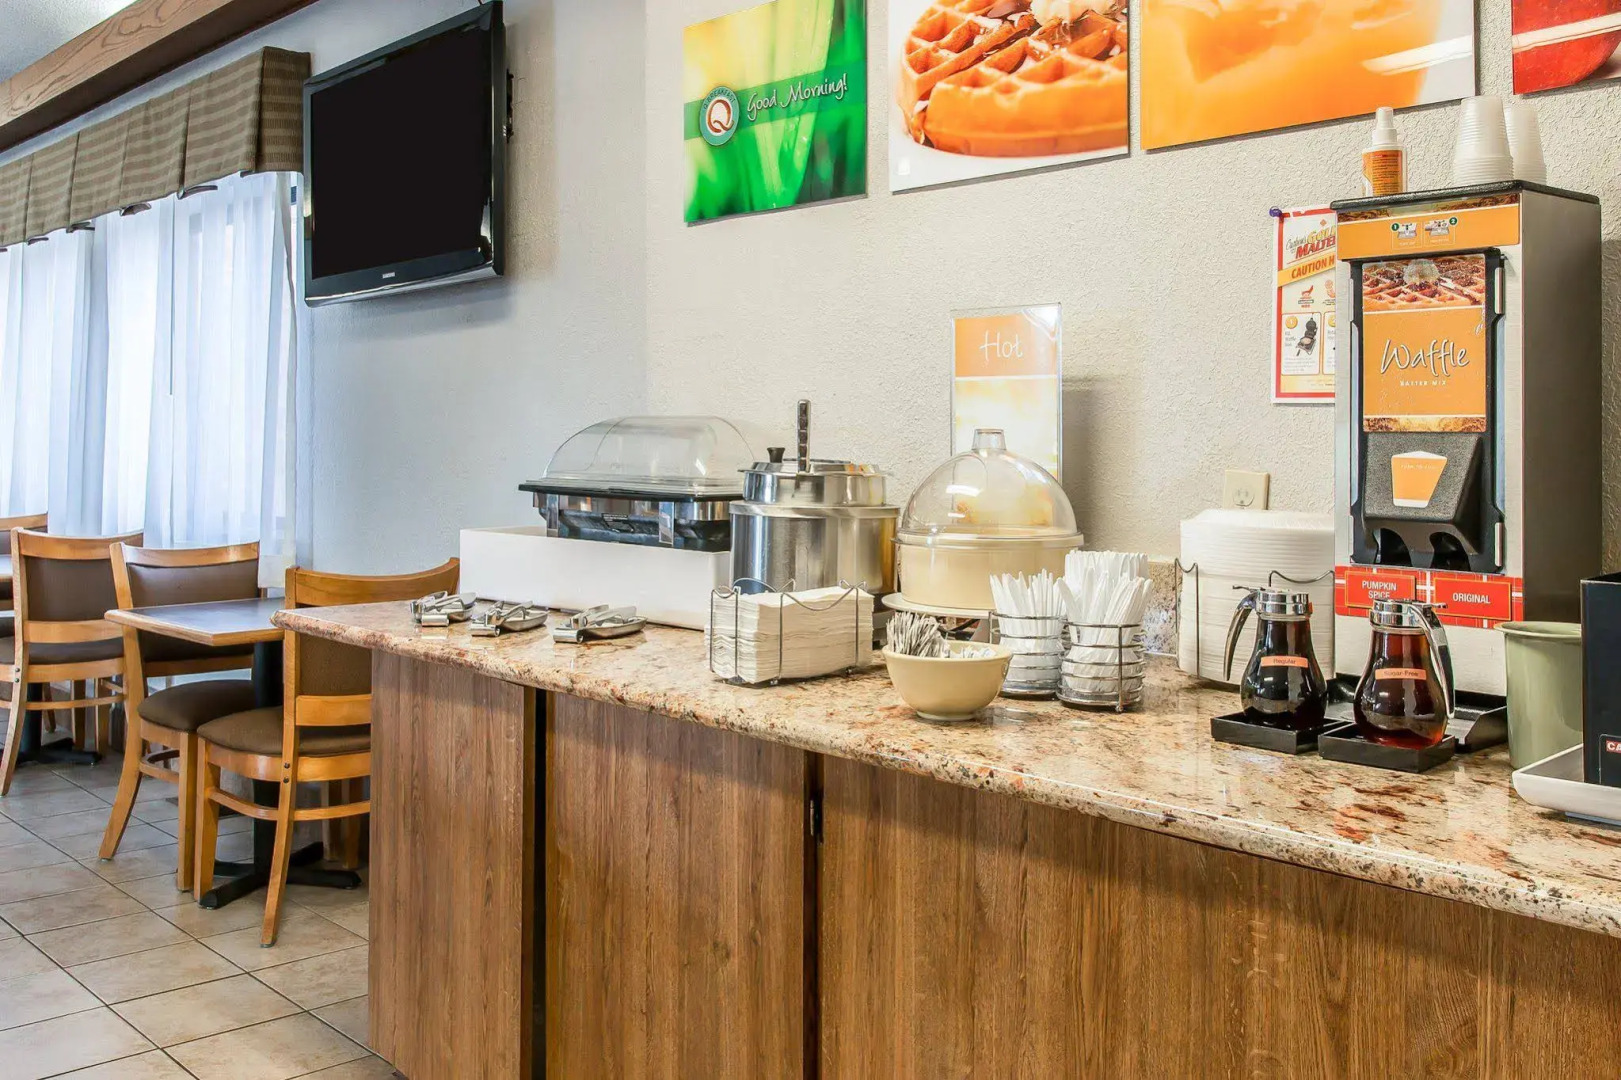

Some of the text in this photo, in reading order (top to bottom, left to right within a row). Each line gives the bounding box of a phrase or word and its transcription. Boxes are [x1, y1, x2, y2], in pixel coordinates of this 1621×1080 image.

[747, 73, 848, 121] Good Morning!
[707, 98, 735, 134] Q
[1291, 257, 1328, 279] CAUTION
[979, 329, 1024, 362] Hot
[1380, 339, 1470, 377] Waffle
[1362, 580, 1397, 591] PUMPKIN
[1452, 592, 1491, 604] ORIGINAL
